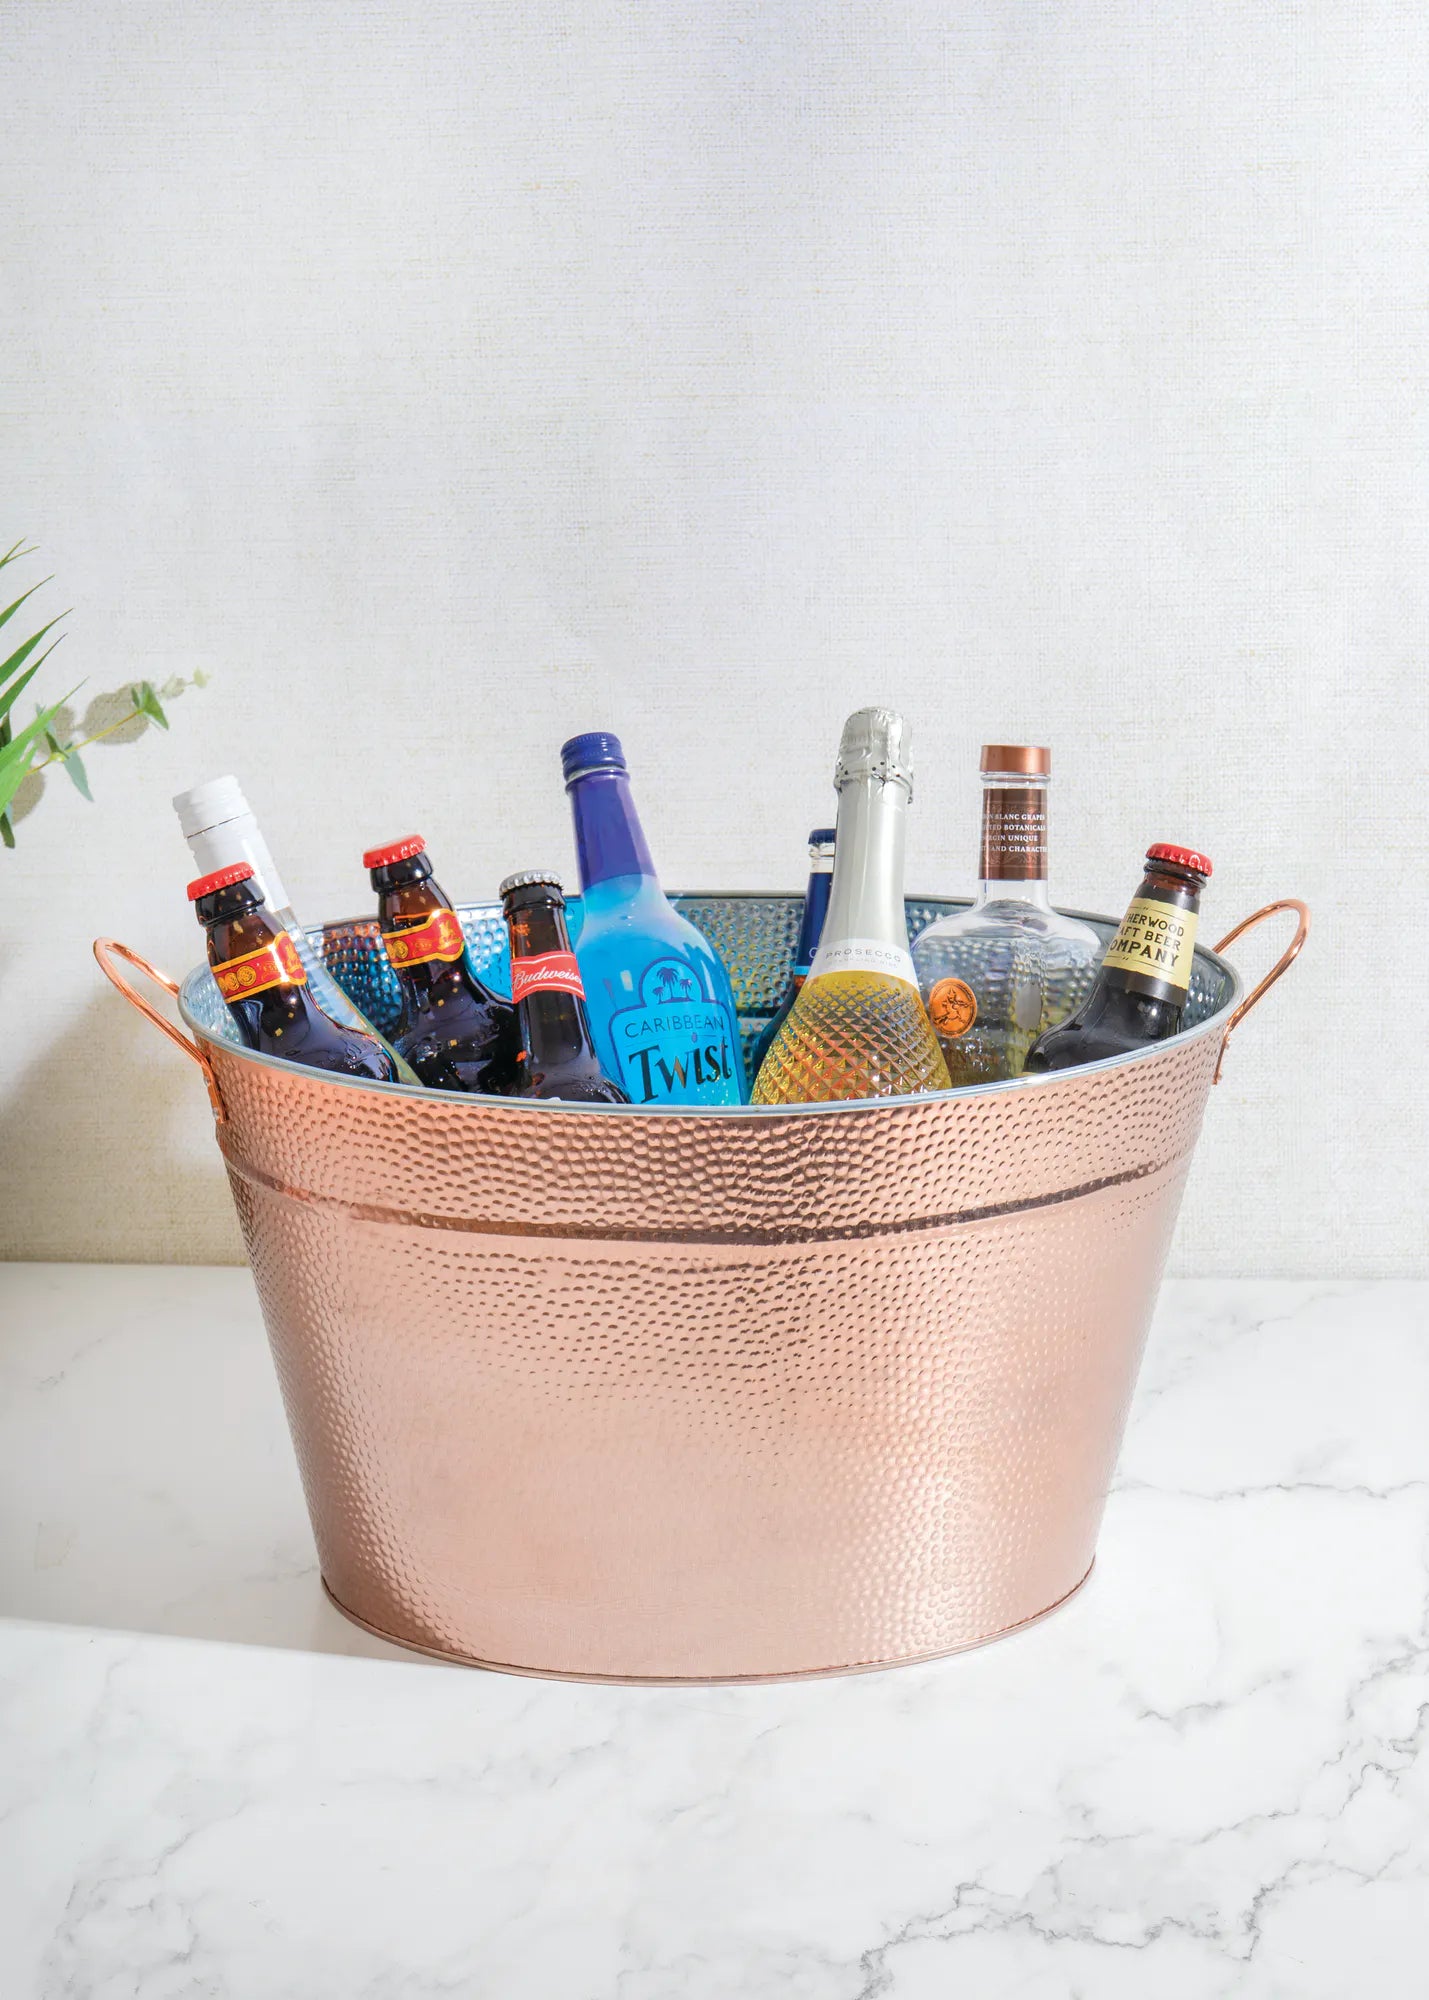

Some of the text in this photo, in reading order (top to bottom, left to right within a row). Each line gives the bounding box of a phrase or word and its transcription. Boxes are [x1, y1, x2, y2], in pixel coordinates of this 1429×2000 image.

[995, 813, 1020, 821] BLANC
[1008, 834, 1038, 842] UNIQUE
[1126, 913, 1184, 937] HERWOOD
[1120, 926, 1181, 951] AFT BEER
[825, 948, 901, 962] PROSECCO
[1110, 939, 1179, 967] OMPANY
[624, 1014, 725, 1038] CARIBBEAN
[628, 1034, 733, 1104] Twist
